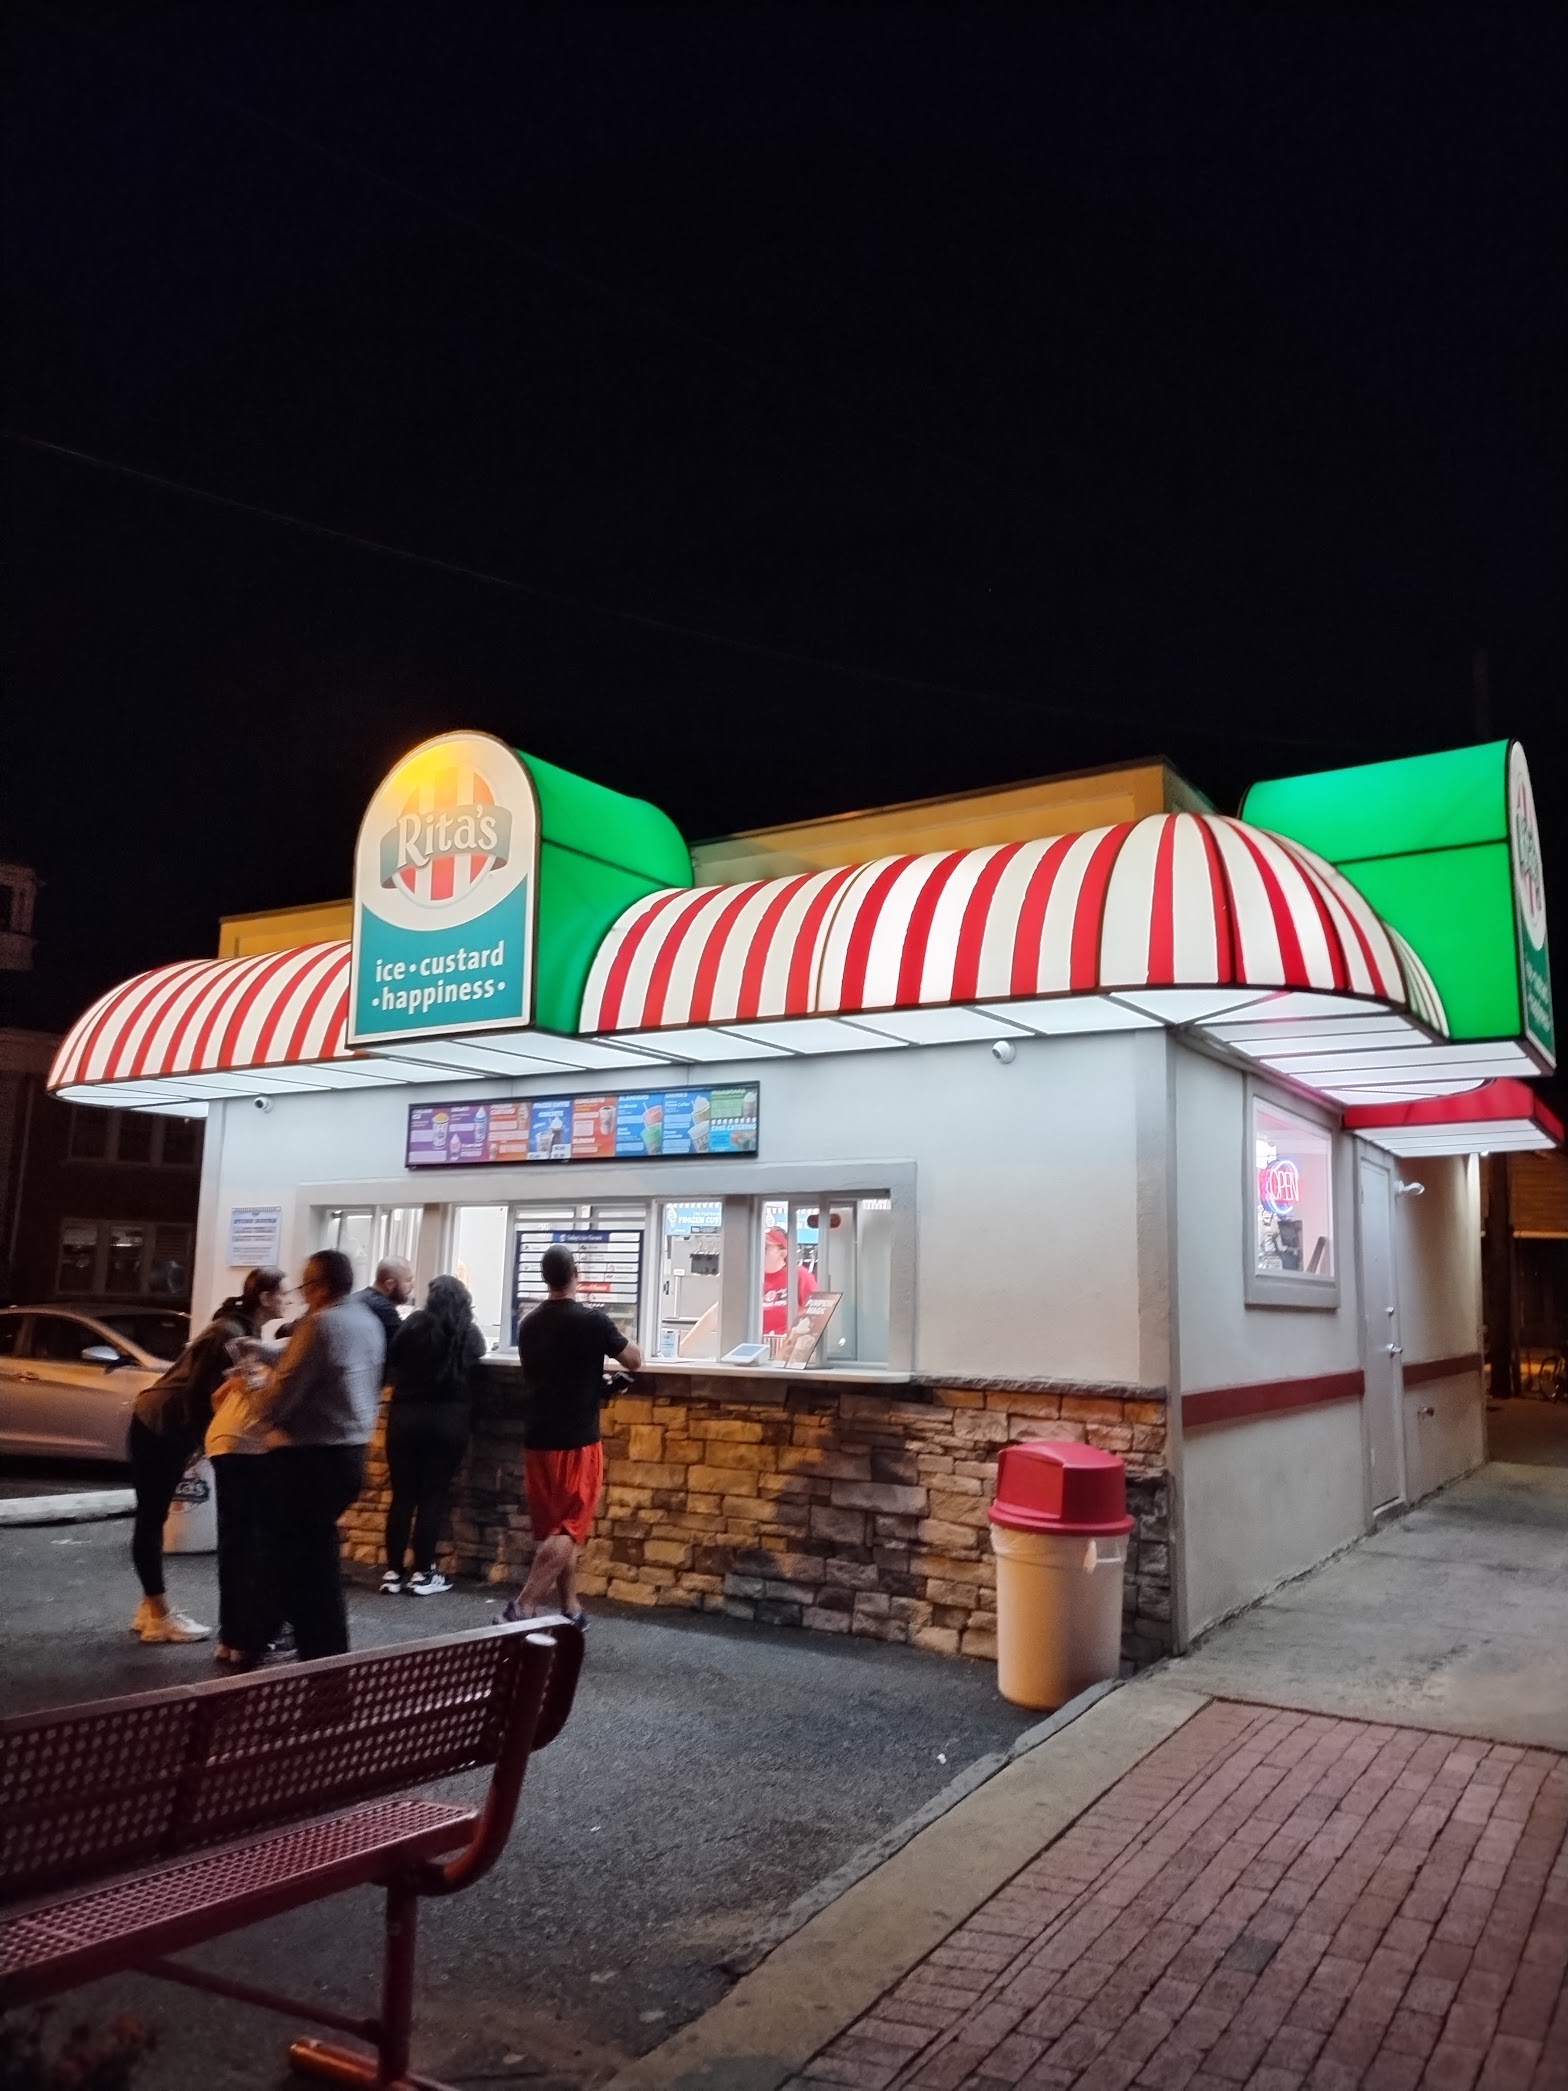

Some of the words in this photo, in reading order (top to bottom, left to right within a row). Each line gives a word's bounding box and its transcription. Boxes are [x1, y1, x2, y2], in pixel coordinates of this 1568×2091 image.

[396, 804, 498, 869] Rita's
[1270, 1169, 1299, 1201] OPEN
[679, 1216, 705, 1224] FROZEN
